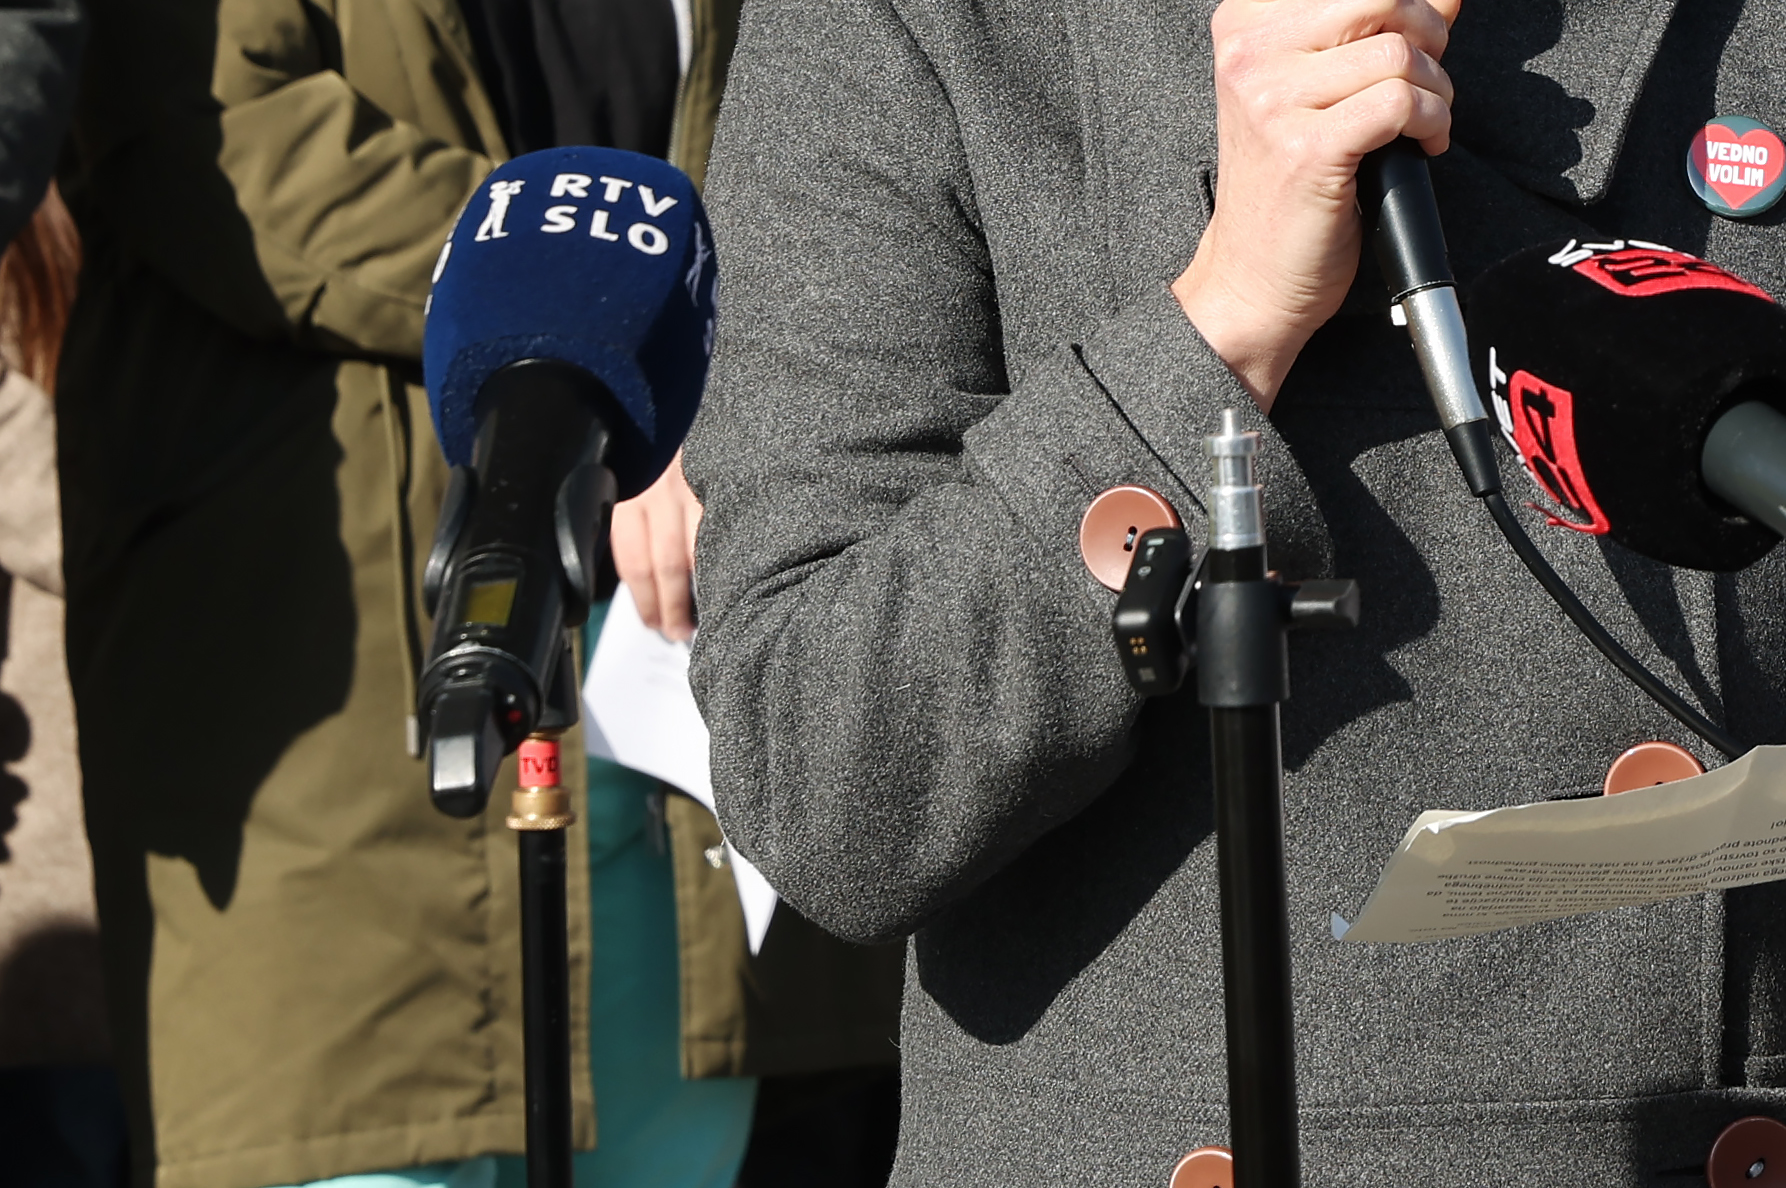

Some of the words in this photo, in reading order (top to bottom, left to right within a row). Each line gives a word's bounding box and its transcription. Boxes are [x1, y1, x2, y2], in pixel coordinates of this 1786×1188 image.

[1706, 140, 1768, 166] VEDNO
[1708, 163, 1765, 188] VOLIM
[550, 173, 678, 217] RTV
[540, 205, 669, 255] SLO
